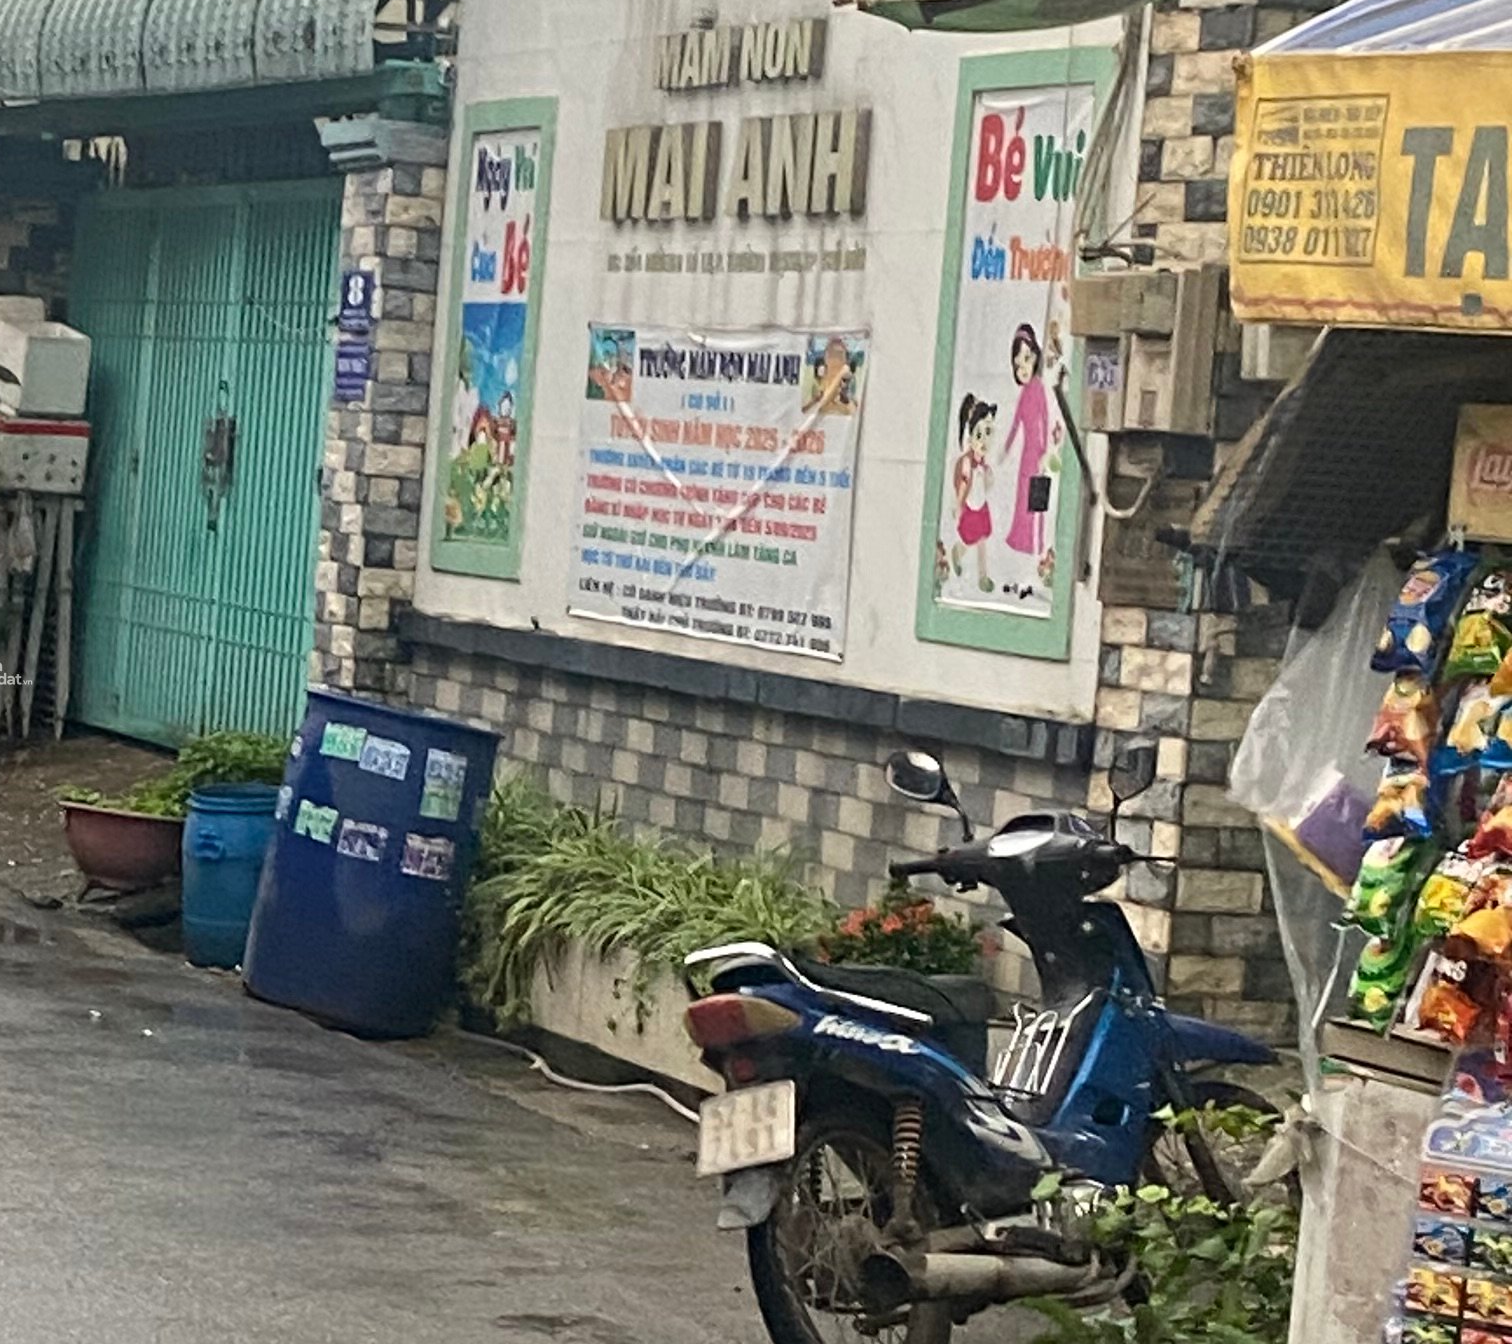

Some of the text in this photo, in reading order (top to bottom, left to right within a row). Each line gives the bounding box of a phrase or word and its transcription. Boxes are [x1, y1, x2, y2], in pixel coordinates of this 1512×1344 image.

[741, 17, 826, 82] NON
[599, 109, 872, 223] MAI ANH
[975, 106, 1086, 202] Bé Vui
[1247, 188, 1302, 219] 0901
[501, 212, 530, 294] Bé
[1243, 226, 1299, 256] 0938
[347, 274, 365, 306] 8
